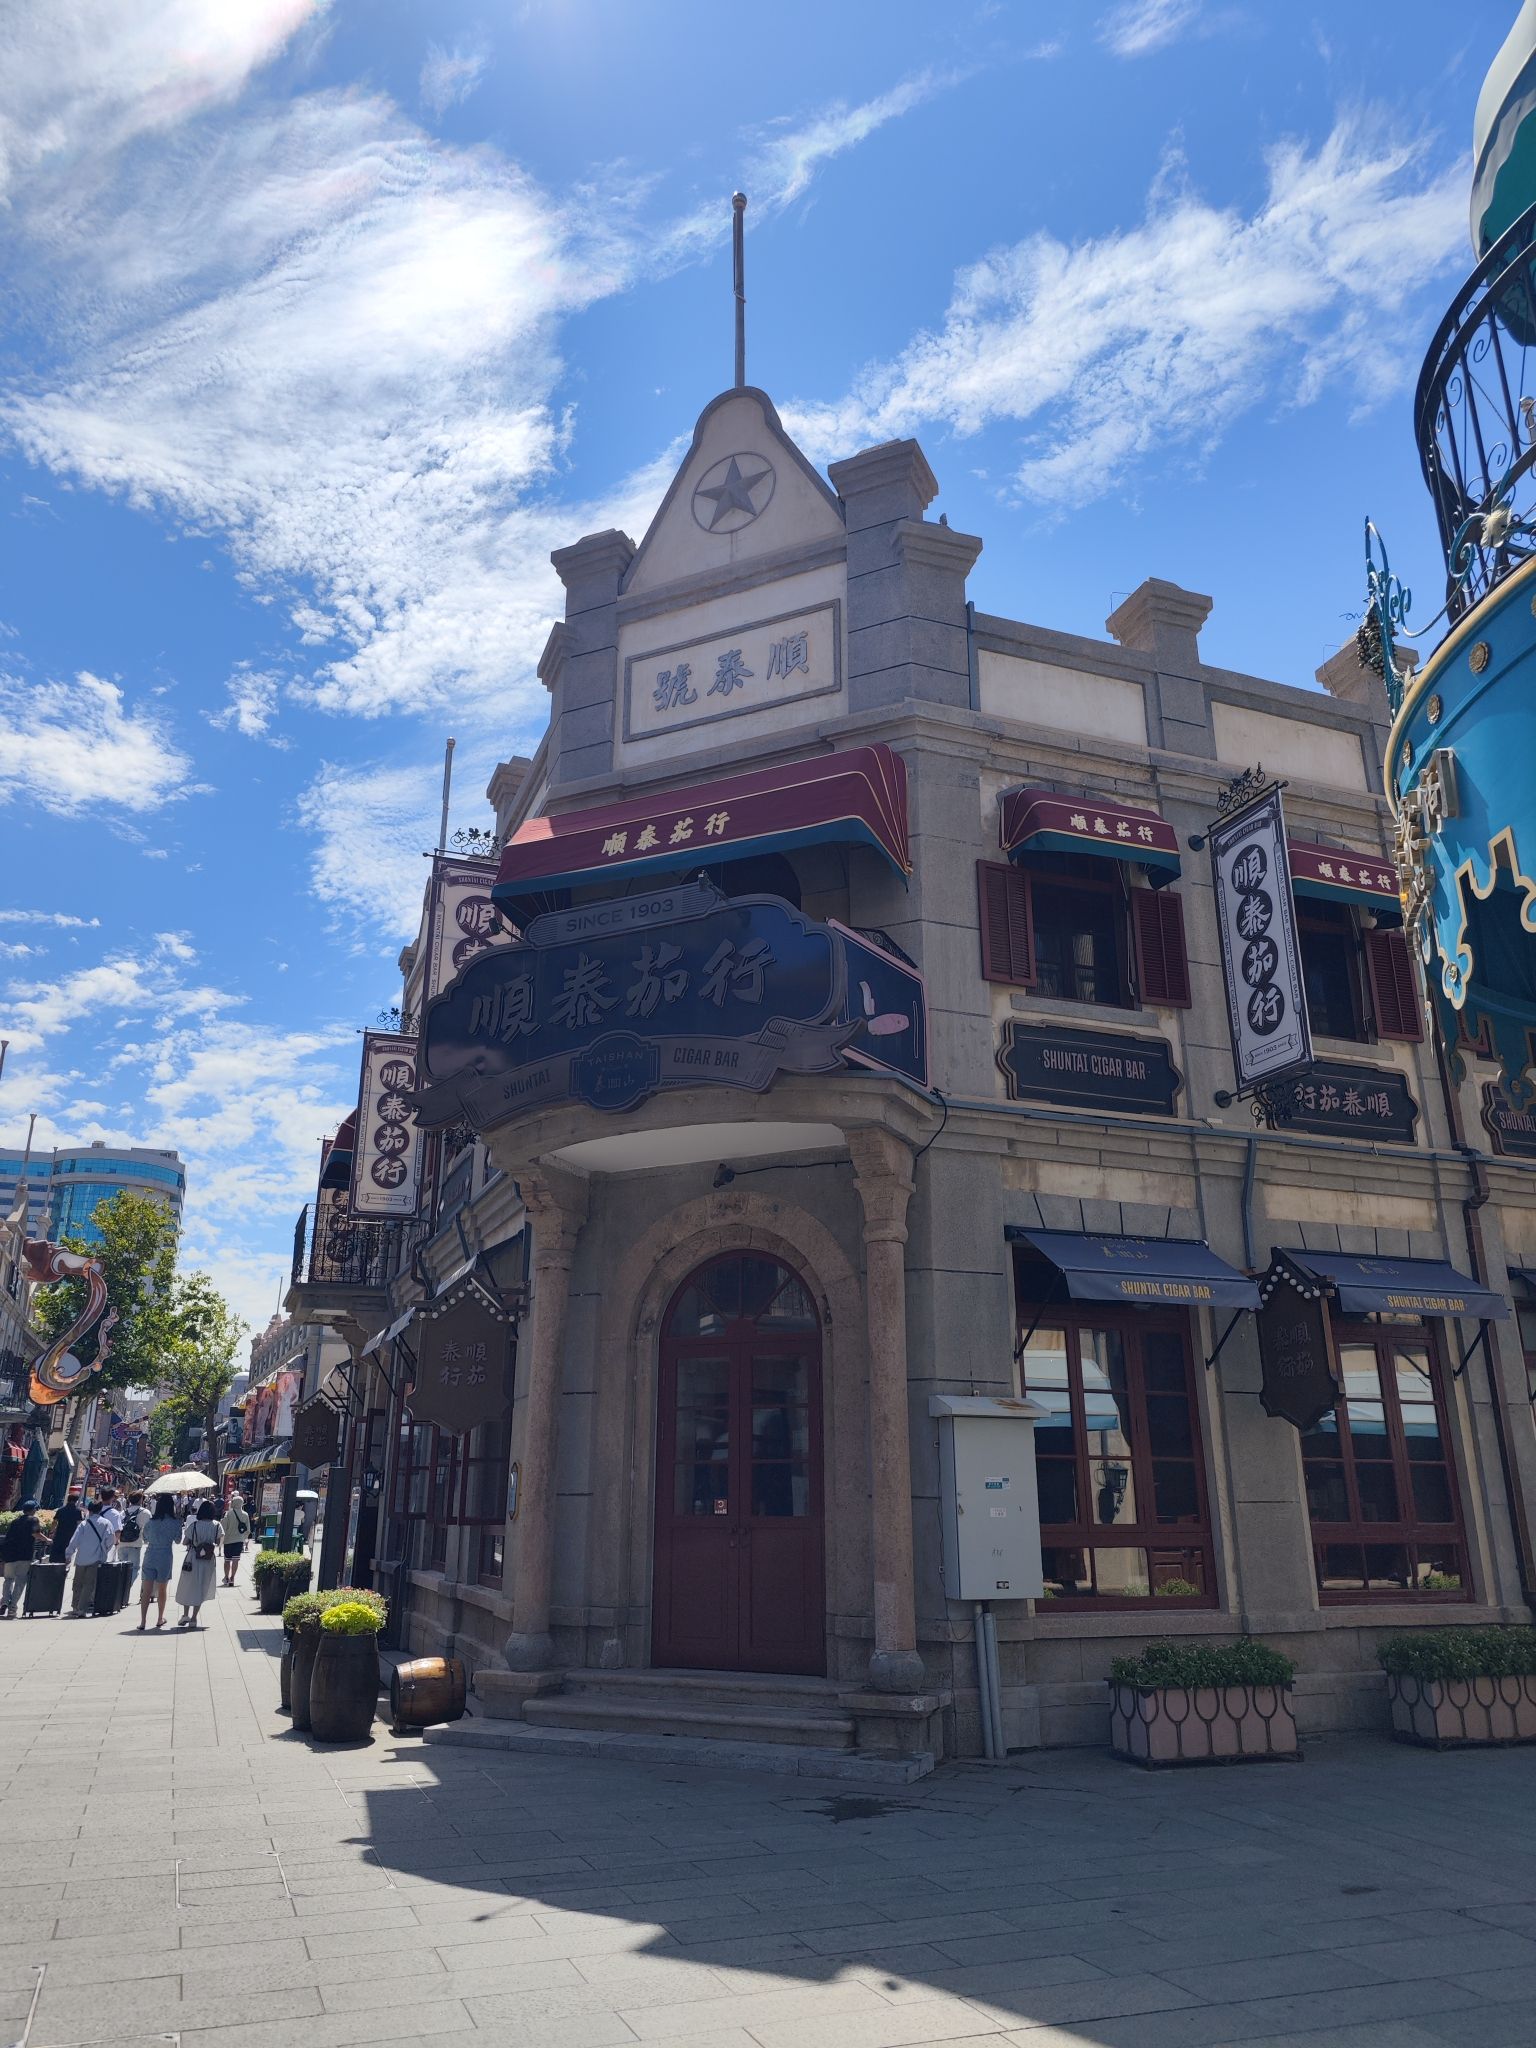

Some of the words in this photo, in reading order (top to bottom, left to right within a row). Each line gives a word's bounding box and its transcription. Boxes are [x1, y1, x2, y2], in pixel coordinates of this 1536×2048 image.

[566, 909, 623, 933] SINCE
[630, 899, 674, 919] 1903
[1233, 848, 1281, 1027] 順泰茄行
[469, 937, 776, 1044] 順泰茄行
[588, 1051, 644, 1067] TAISHAN
[673, 1047, 710, 1066] CIGAR
[714, 1049, 740, 1068] BAR
[1043, 1049, 1089, 1073] SHUNTAI
[1090, 1054, 1123, 1078] CIGAR
[1125, 1059, 1146, 1080] BAR
[503, 1068, 550, 1100] SHUNTAI
[1121, 1280, 1162, 1296] SHUNTAI
[1163, 1283, 1191, 1298] CIGAR
[1192, 1285, 1211, 1299] BAR
[1387, 1295, 1424, 1309] SHUNTAI
[1424, 1297, 1447, 1310] CIGAR
[1448, 1299, 1465, 1312] BAR
